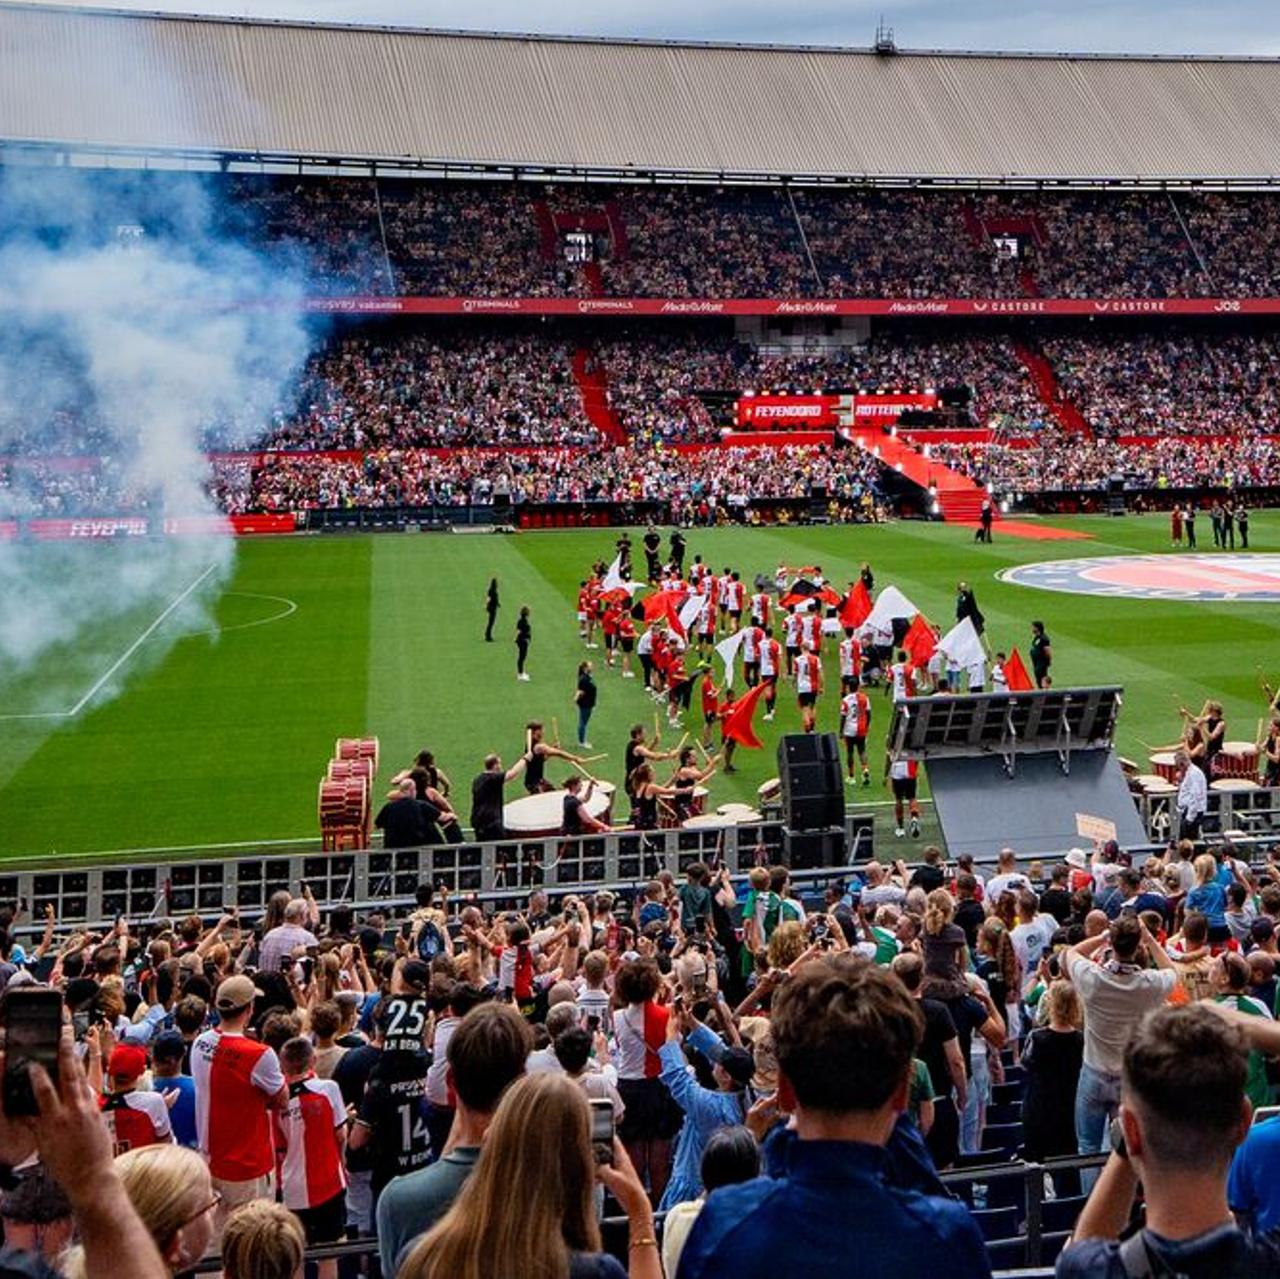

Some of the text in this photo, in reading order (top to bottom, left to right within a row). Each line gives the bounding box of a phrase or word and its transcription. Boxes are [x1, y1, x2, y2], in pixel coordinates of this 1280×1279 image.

[991, 302, 1045, 311] CASTORE
[1112, 302, 1165, 311] CASTORE
[755, 405, 822, 417] FEYENOORD
[386, 999, 426, 1036] 25
[398, 1104, 431, 1152] 14
